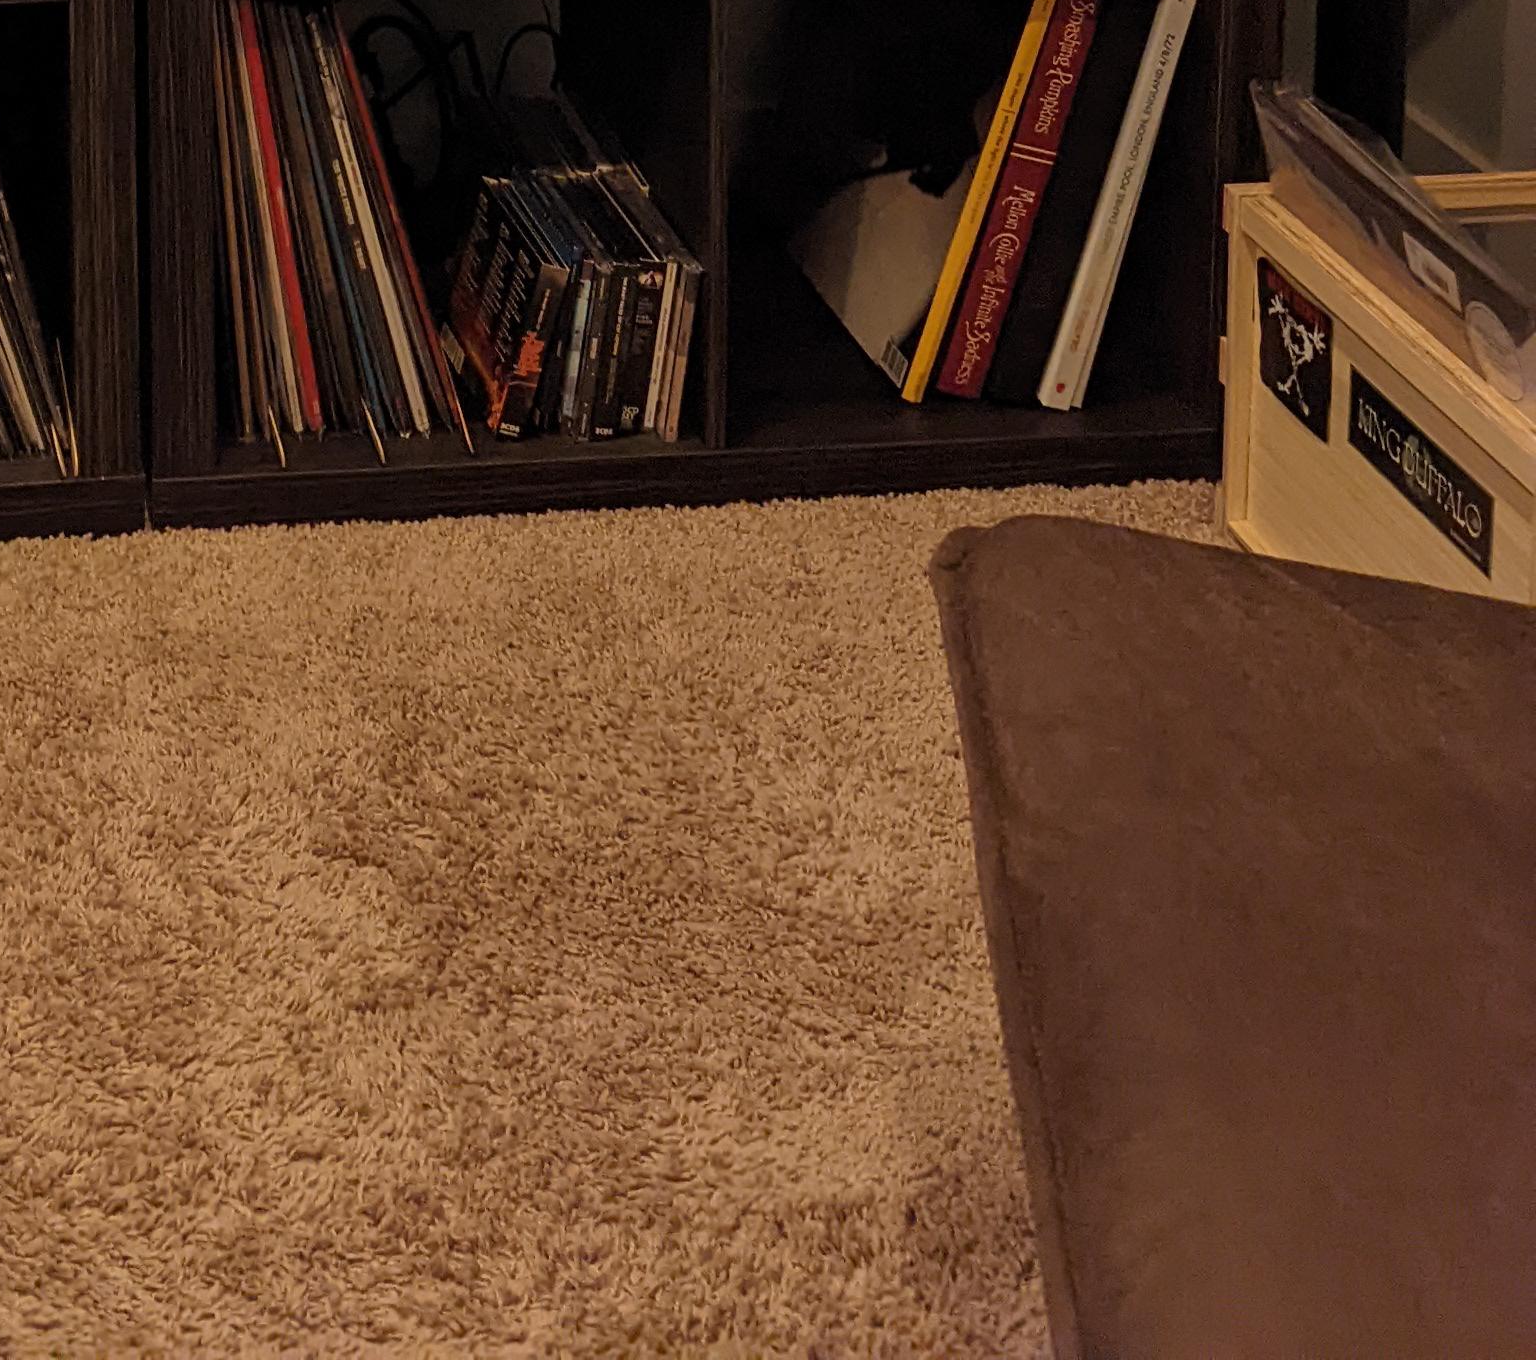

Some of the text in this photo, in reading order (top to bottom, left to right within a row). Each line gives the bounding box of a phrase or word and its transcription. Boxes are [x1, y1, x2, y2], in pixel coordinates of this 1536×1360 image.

[1034, 67, 1073, 136] Pumpkins
[1142, 68, 1164, 115] ENGLAND
[1002, 185, 1036, 230] Mellon
[989, 233, 1020, 265] Collie
[975, 284, 1005, 329] Infinite
[956, 321, 990, 384] Sadness
[1358, 398, 1482, 538] KING BUFFALO
